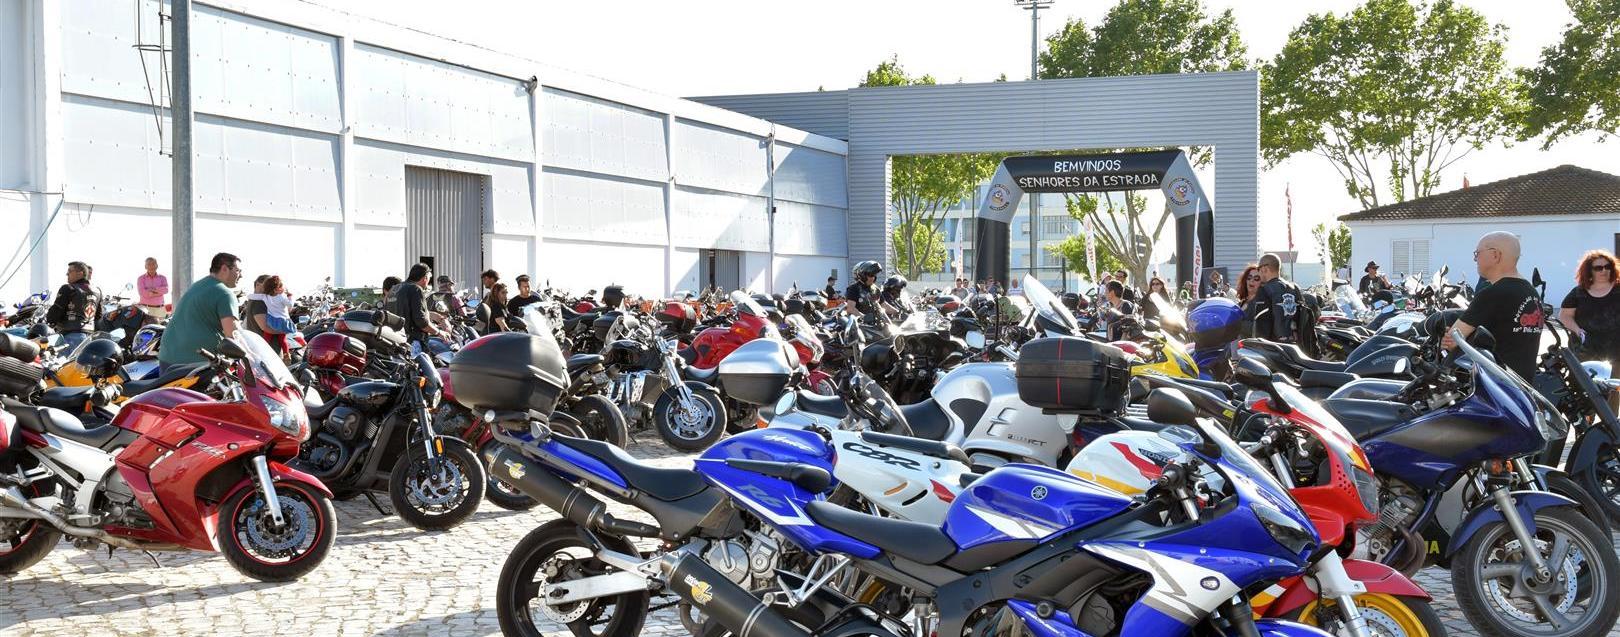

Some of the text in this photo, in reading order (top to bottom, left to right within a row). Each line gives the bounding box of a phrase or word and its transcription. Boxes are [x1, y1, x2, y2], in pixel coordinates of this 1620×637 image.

[1054, 160, 1121, 173] BEMVINDOS
[1019, 176, 1080, 188] SENHORES
[1083, 176, 1100, 187] DA
[1102, 174, 1159, 186] ESTRADA
[842, 442, 922, 471] CBR
[1140, 449, 1169, 463] HOND
